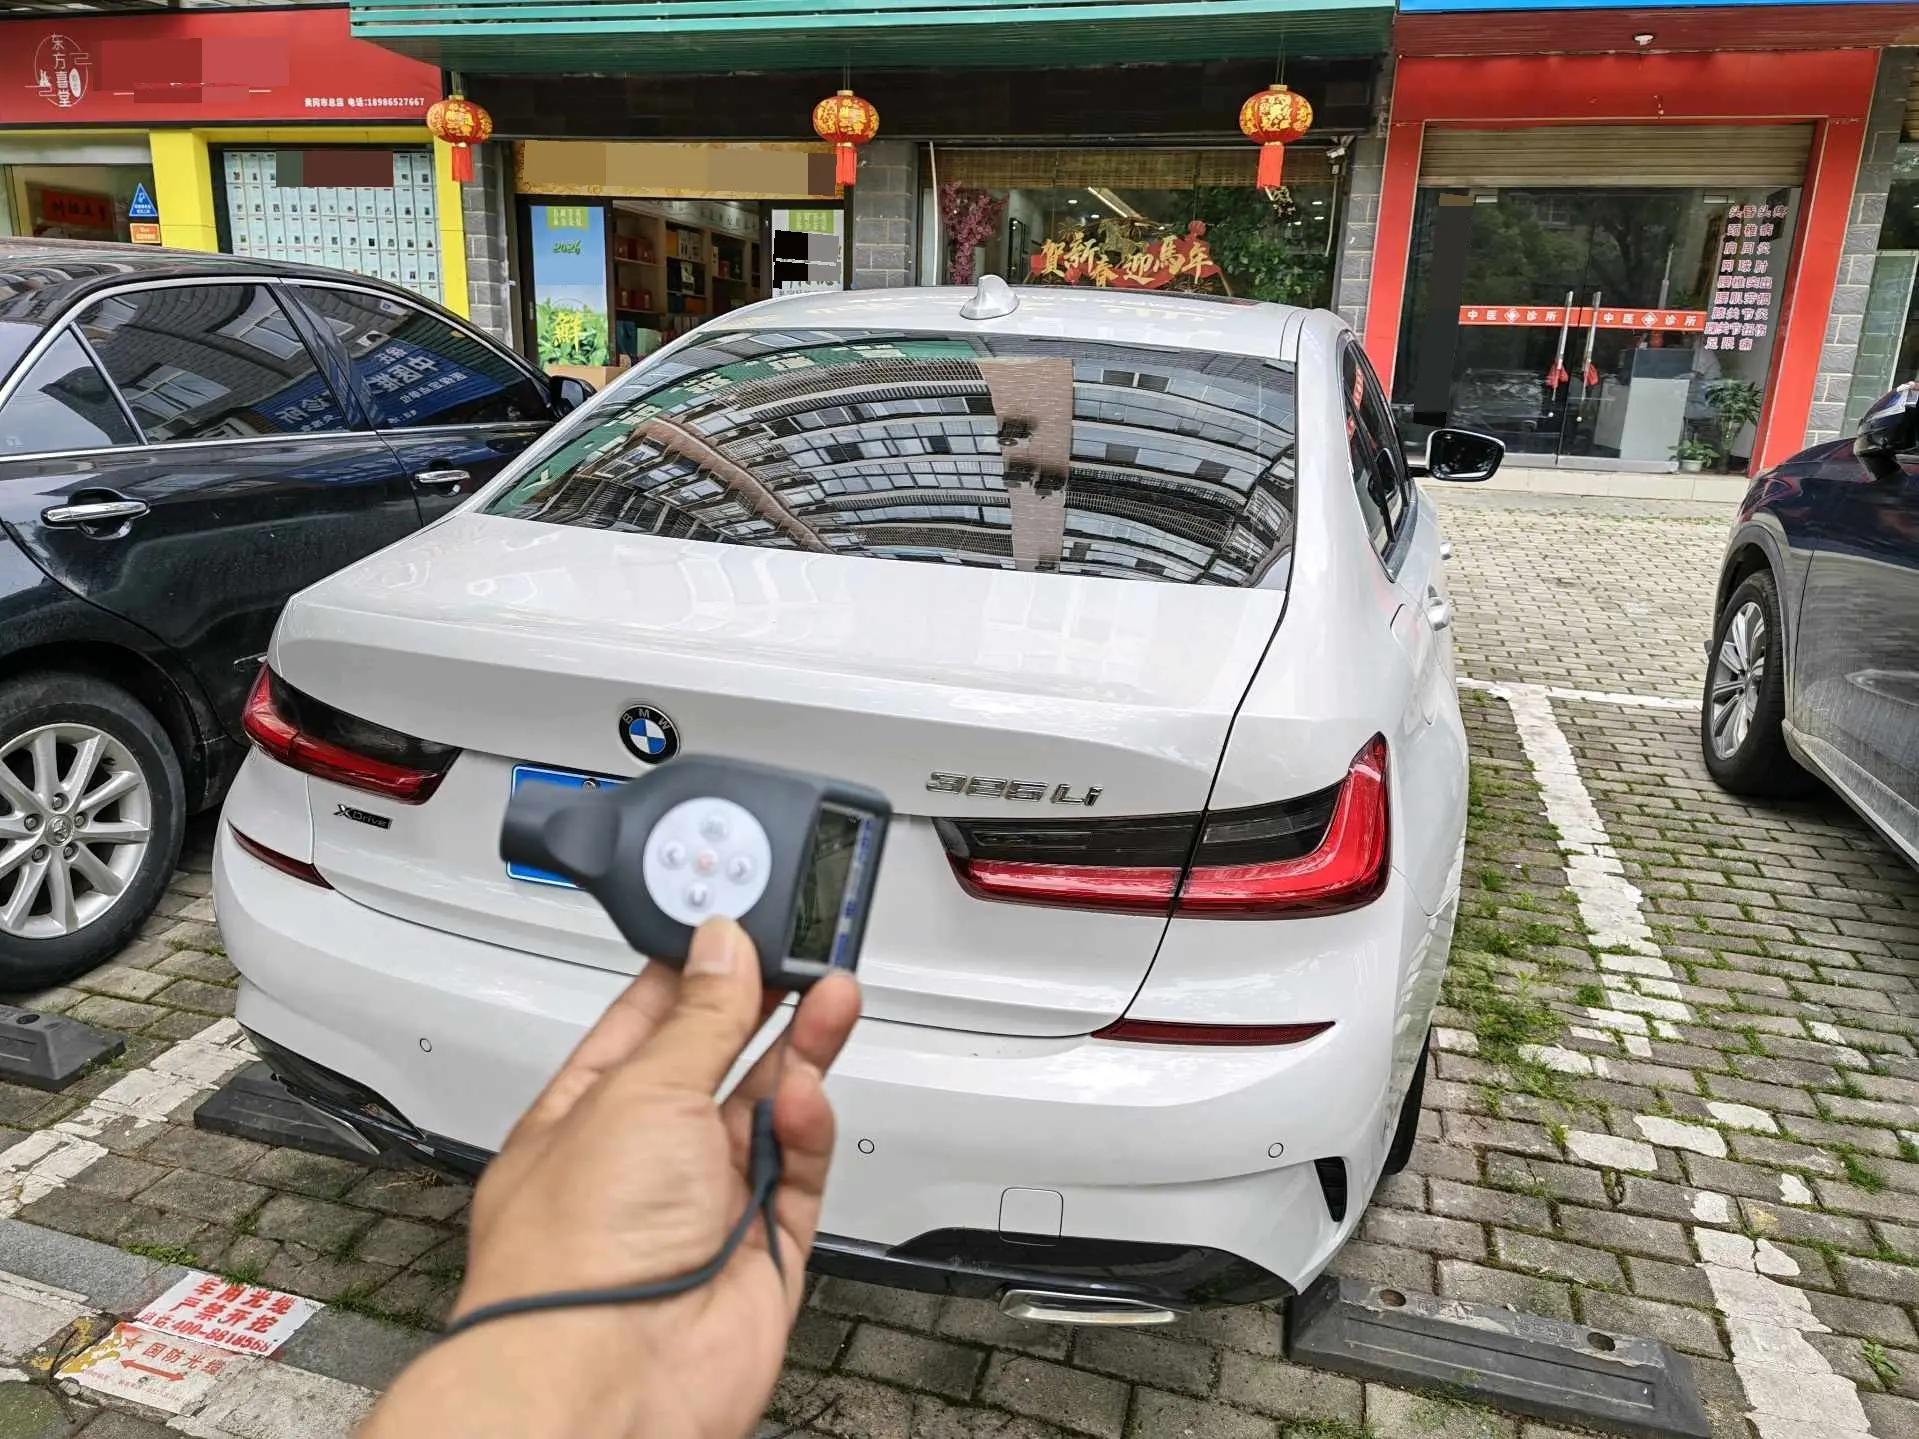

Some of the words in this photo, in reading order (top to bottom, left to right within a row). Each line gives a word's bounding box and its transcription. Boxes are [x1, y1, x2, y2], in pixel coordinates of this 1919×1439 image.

[1726, 223, 1774, 237] 颈椎病
[1723, 241, 1770, 255] 肩周炎
[1720, 259, 1768, 273] 网球肘
[1711, 306, 1768, 320] 膝关节炎
[622, 708, 672, 730] BMW
[169, 1296, 279, 1333] 严禁开挖
[143, 1341, 227, 1376] 国防光缆
